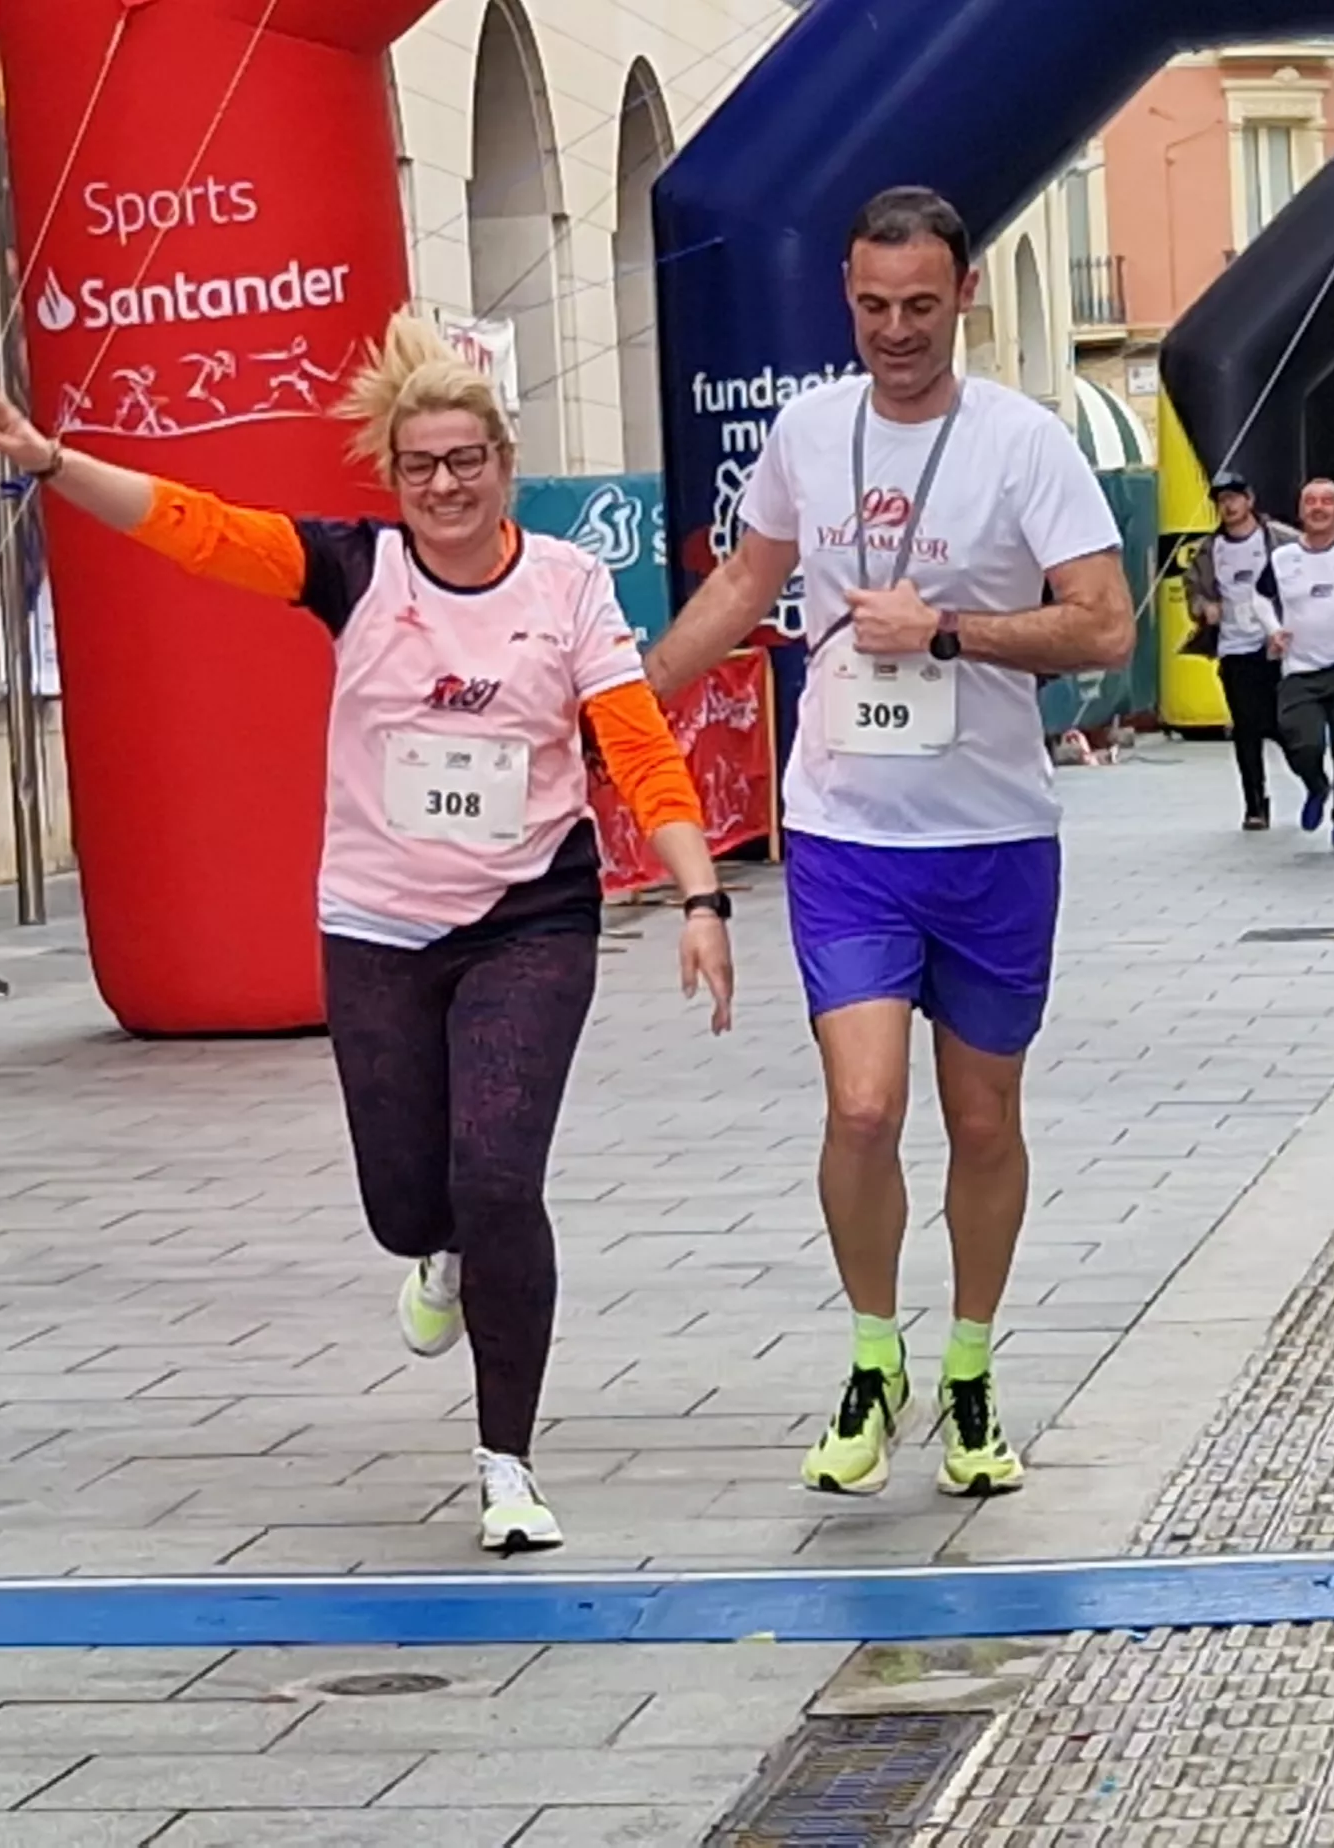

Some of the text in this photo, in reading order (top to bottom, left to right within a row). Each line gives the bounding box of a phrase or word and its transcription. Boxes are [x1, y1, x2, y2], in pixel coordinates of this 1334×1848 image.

[83, 175, 259, 247] Sports
[80, 260, 350, 329] Santander
[855, 702, 910, 729] 309
[425, 789, 482, 818] 308
